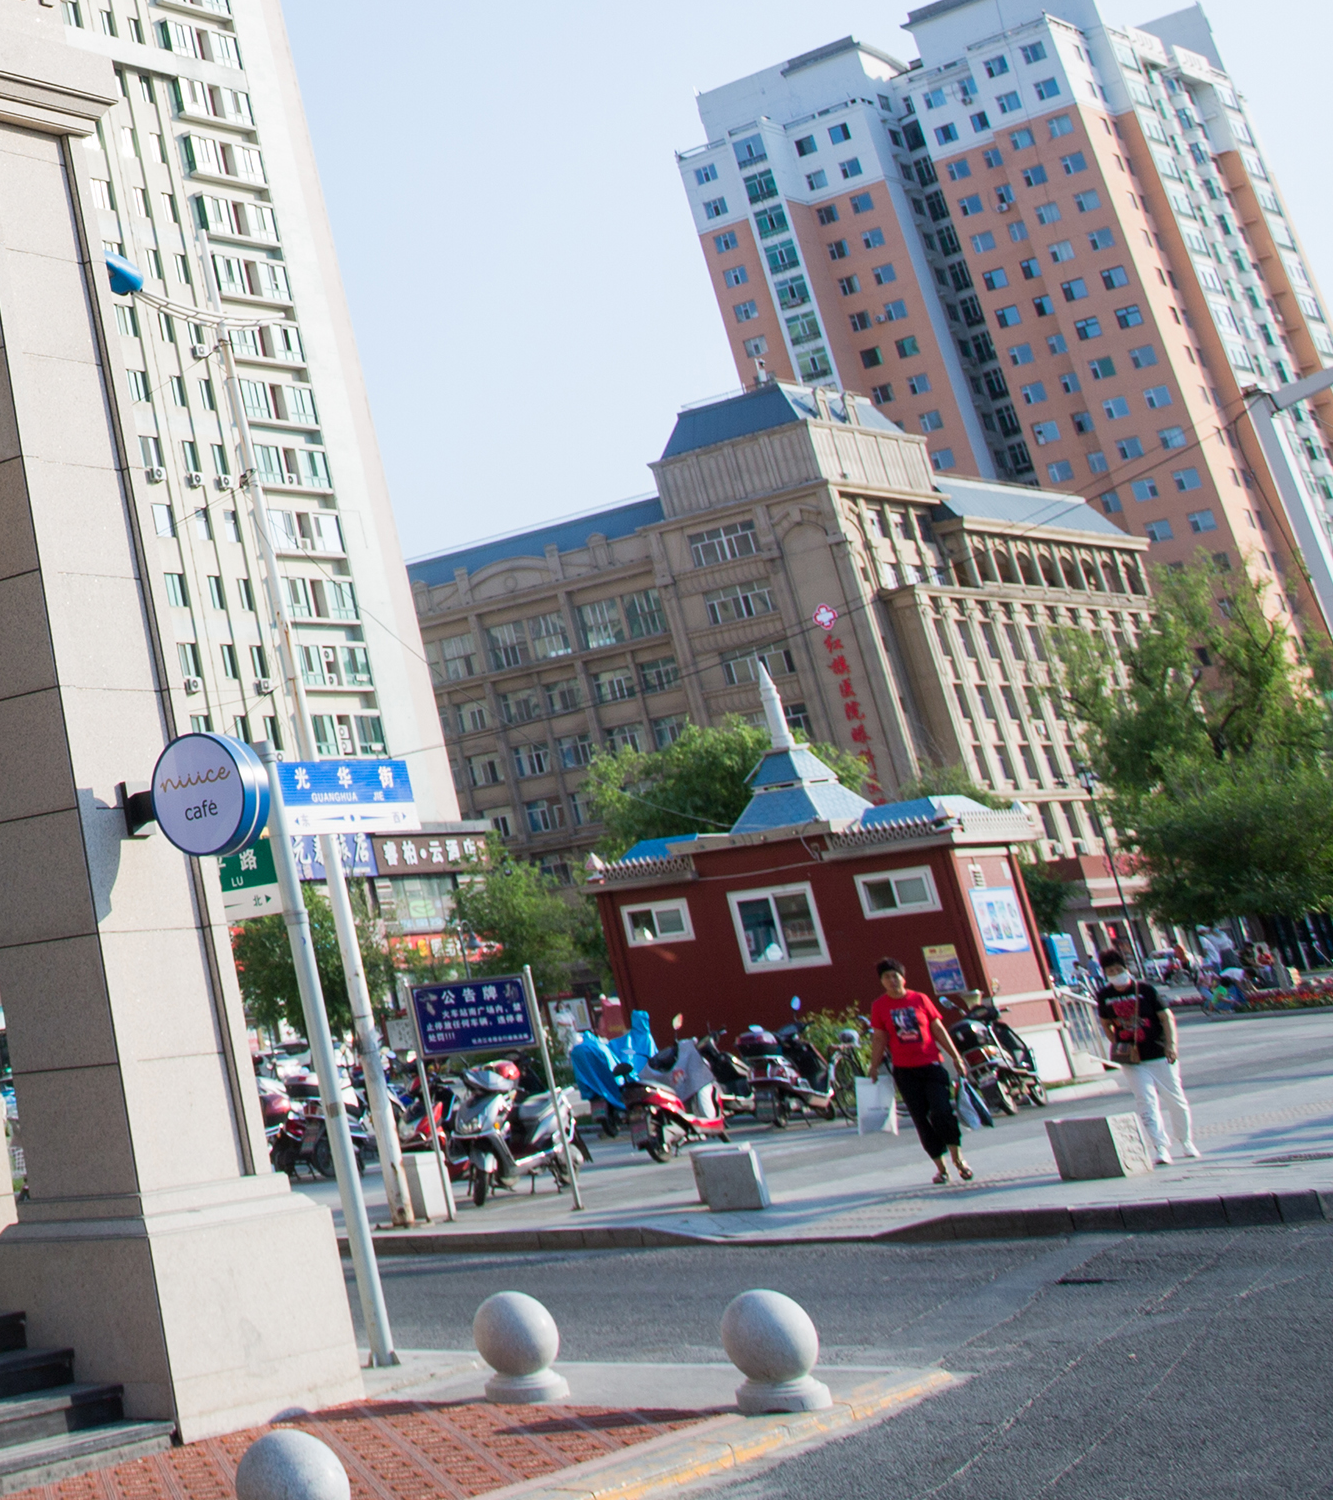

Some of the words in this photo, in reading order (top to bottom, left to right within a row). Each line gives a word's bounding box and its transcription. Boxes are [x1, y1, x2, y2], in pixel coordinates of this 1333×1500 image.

[294, 765, 394, 789] 光华街
[311, 791, 358, 802] GUANGHUA
[373, 790, 384, 801] JIE
[184, 799, 218, 821] café
[231, 875, 244, 887] LU
[253, 894, 263, 907] 北
[441, 985, 498, 1005] 公告牌
